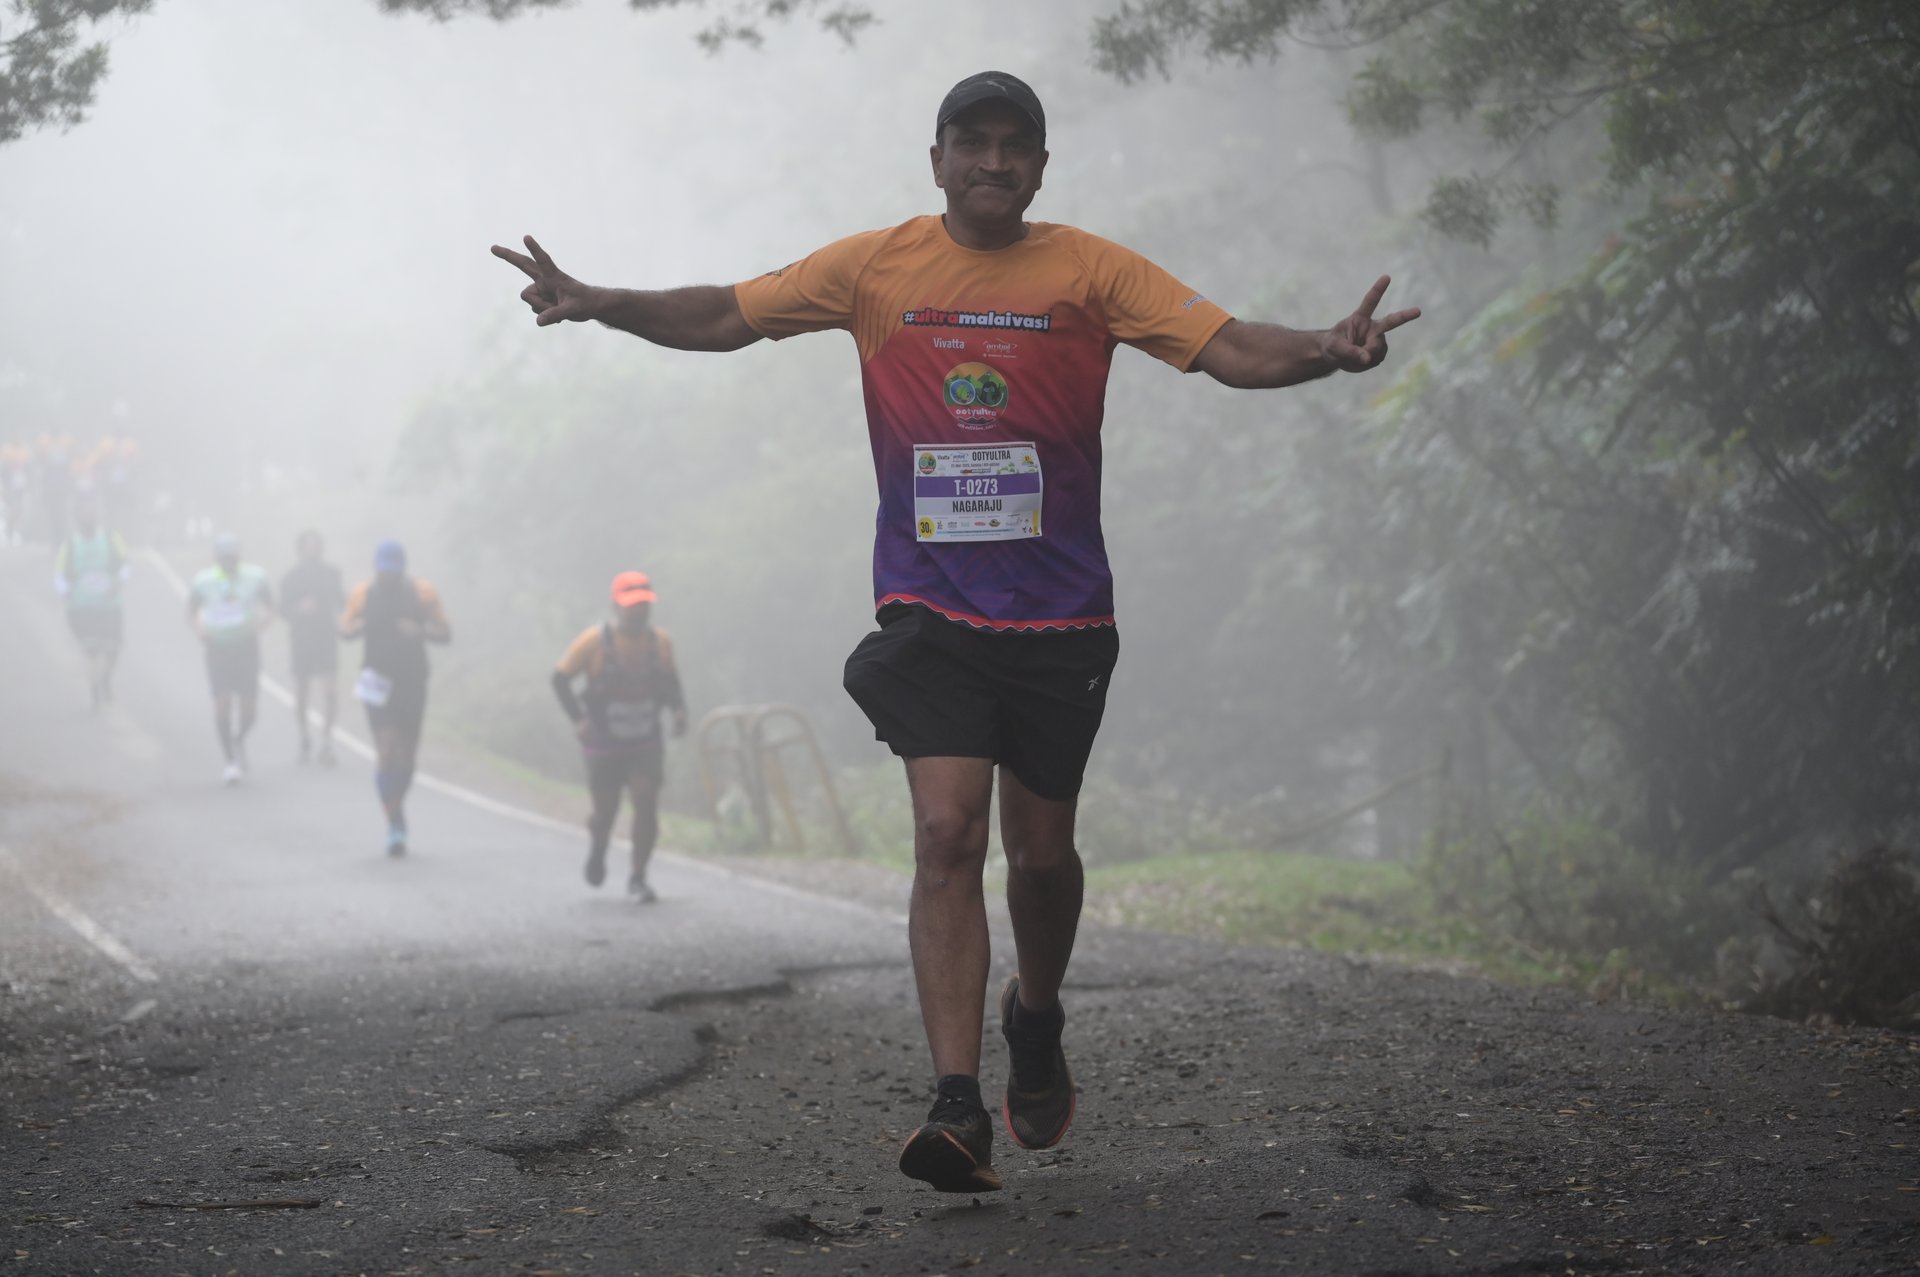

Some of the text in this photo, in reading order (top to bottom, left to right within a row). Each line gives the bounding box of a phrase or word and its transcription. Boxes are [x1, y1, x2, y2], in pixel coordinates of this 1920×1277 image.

[904, 308, 1049, 330] #ultramalaivasi
[933, 337, 965, 349] Vivatta
[972, 450, 1011, 461] OOTYULTRA
[954, 478, 998, 496] T-0273
[952, 499, 1002, 513] NAGARAJU
